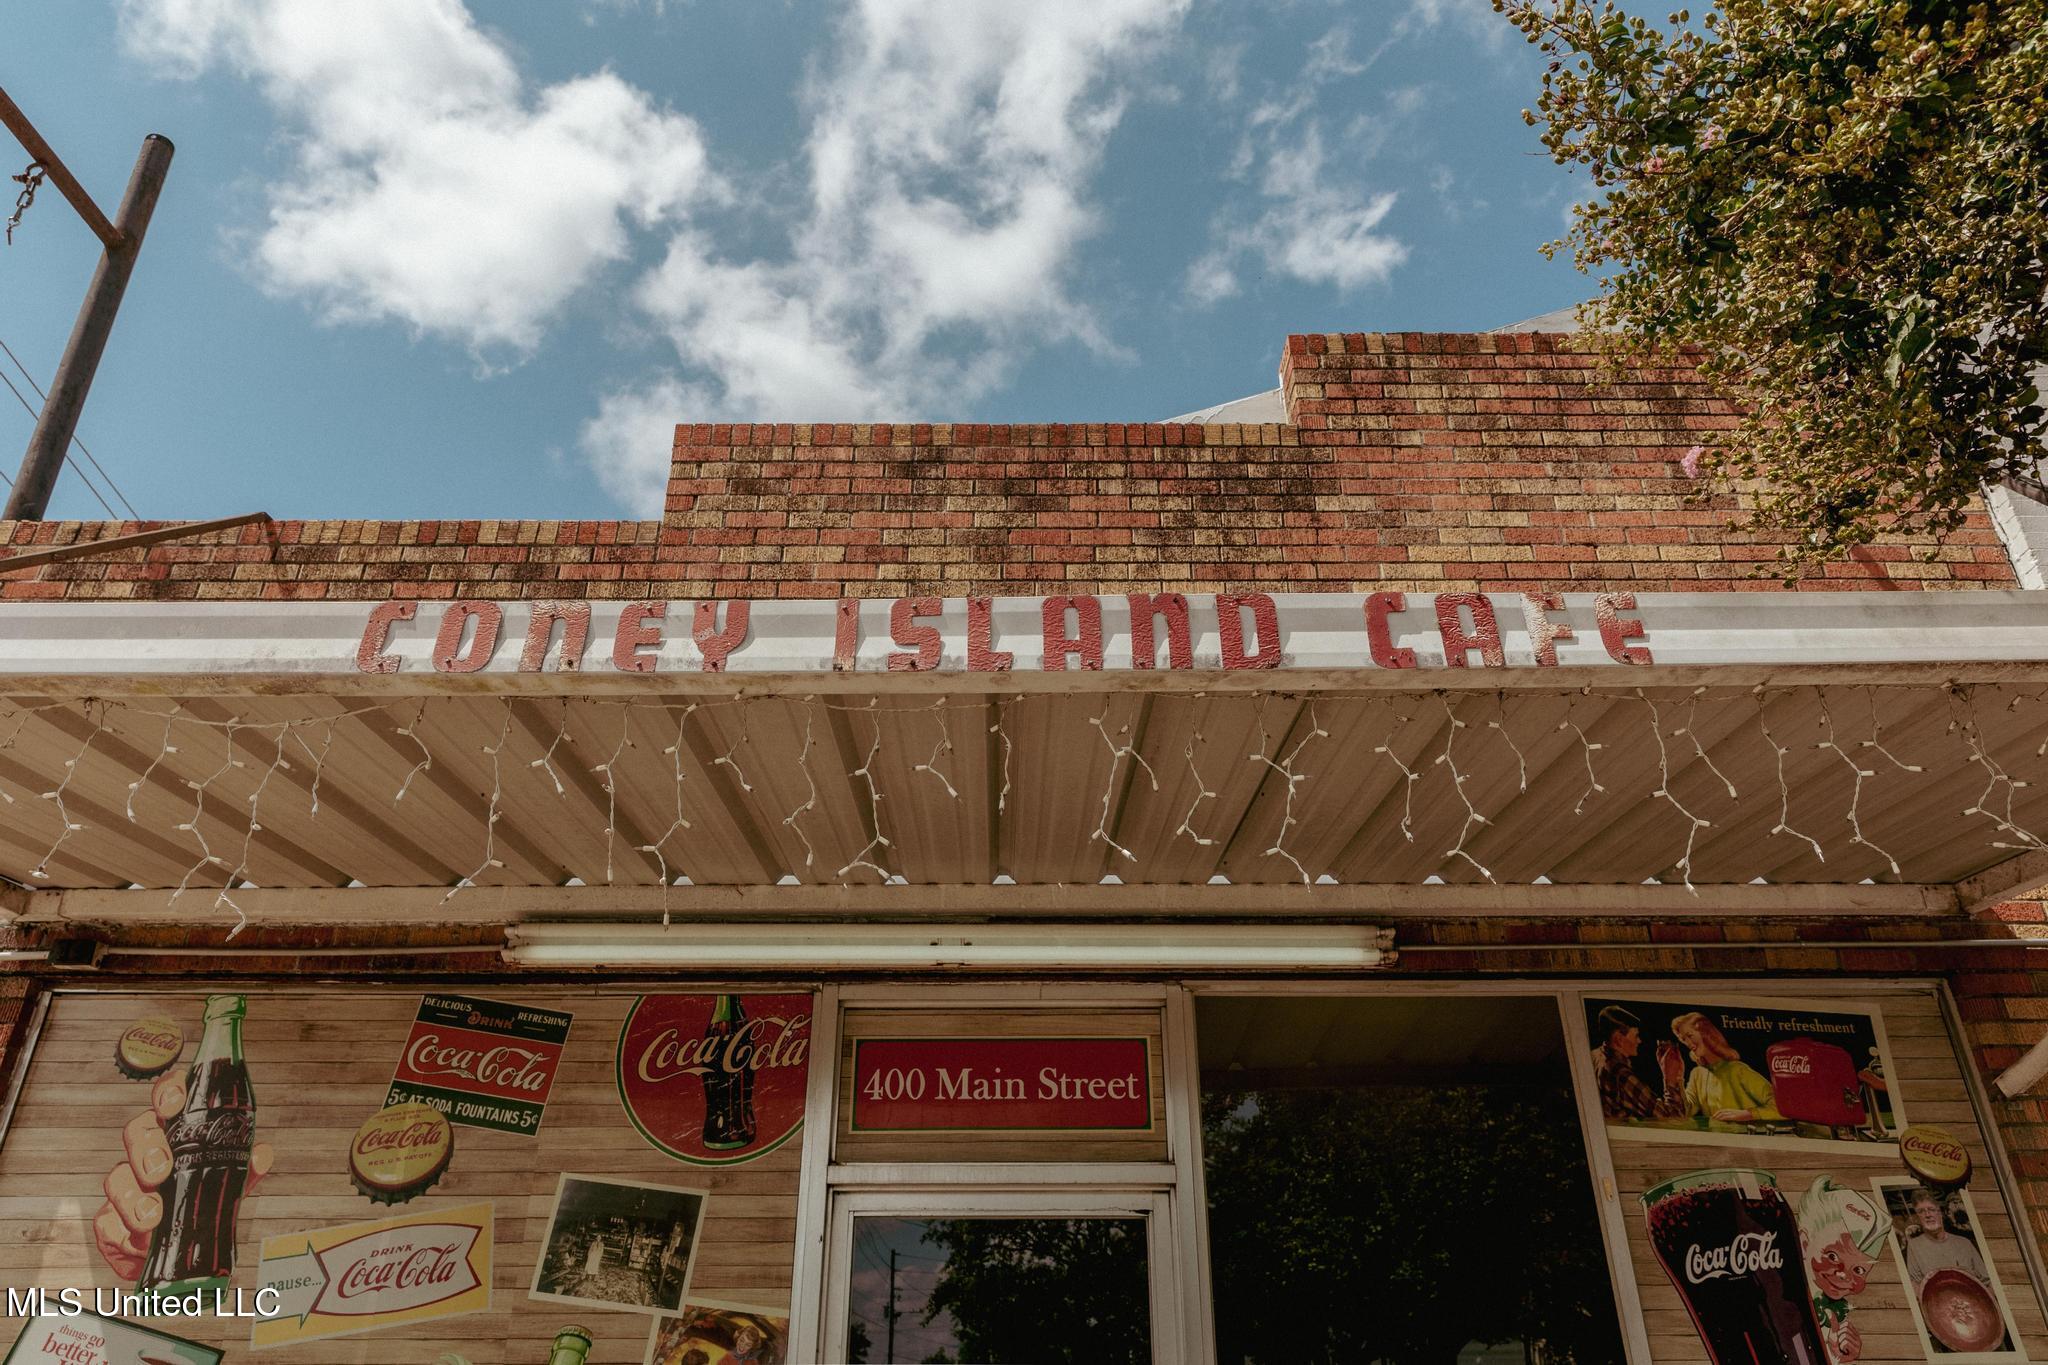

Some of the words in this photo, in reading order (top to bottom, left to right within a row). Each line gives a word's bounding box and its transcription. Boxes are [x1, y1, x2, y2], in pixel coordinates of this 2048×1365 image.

[355, 600, 752, 674] CONEY
[833, 592, 1281, 673] ISLAND
[1363, 591, 1654, 669] CAFE
[424, 997, 473, 1012] DELICIOUS
[517, 1011, 569, 1027] REFRESHING
[467, 1011, 515, 1030] DRINK
[1720, 1014, 1773, 1033] Friendly
[1778, 1017, 1856, 1034] refreshment
[407, 1034, 551, 1091] Coca-Cola
[637, 1014, 812, 1083] Coca-Cola
[863, 1067, 926, 1100] 400
[935, 1067, 1027, 1100] Main
[1038, 1067, 1141, 1100] Street
[455, 1102, 520, 1124] FOUNTAINS
[520, 1110, 539, 1127] 5¢
[357, 1119, 444, 1155] Coca-Cola
[369, 1243, 414, 1258] DRINK
[1685, 1231, 1784, 1284] Coca-Cola
[337, 1241, 463, 1299] Coca-Cola
[59, 1323, 89, 1342] things
[86, 1335, 106, 1349] go
